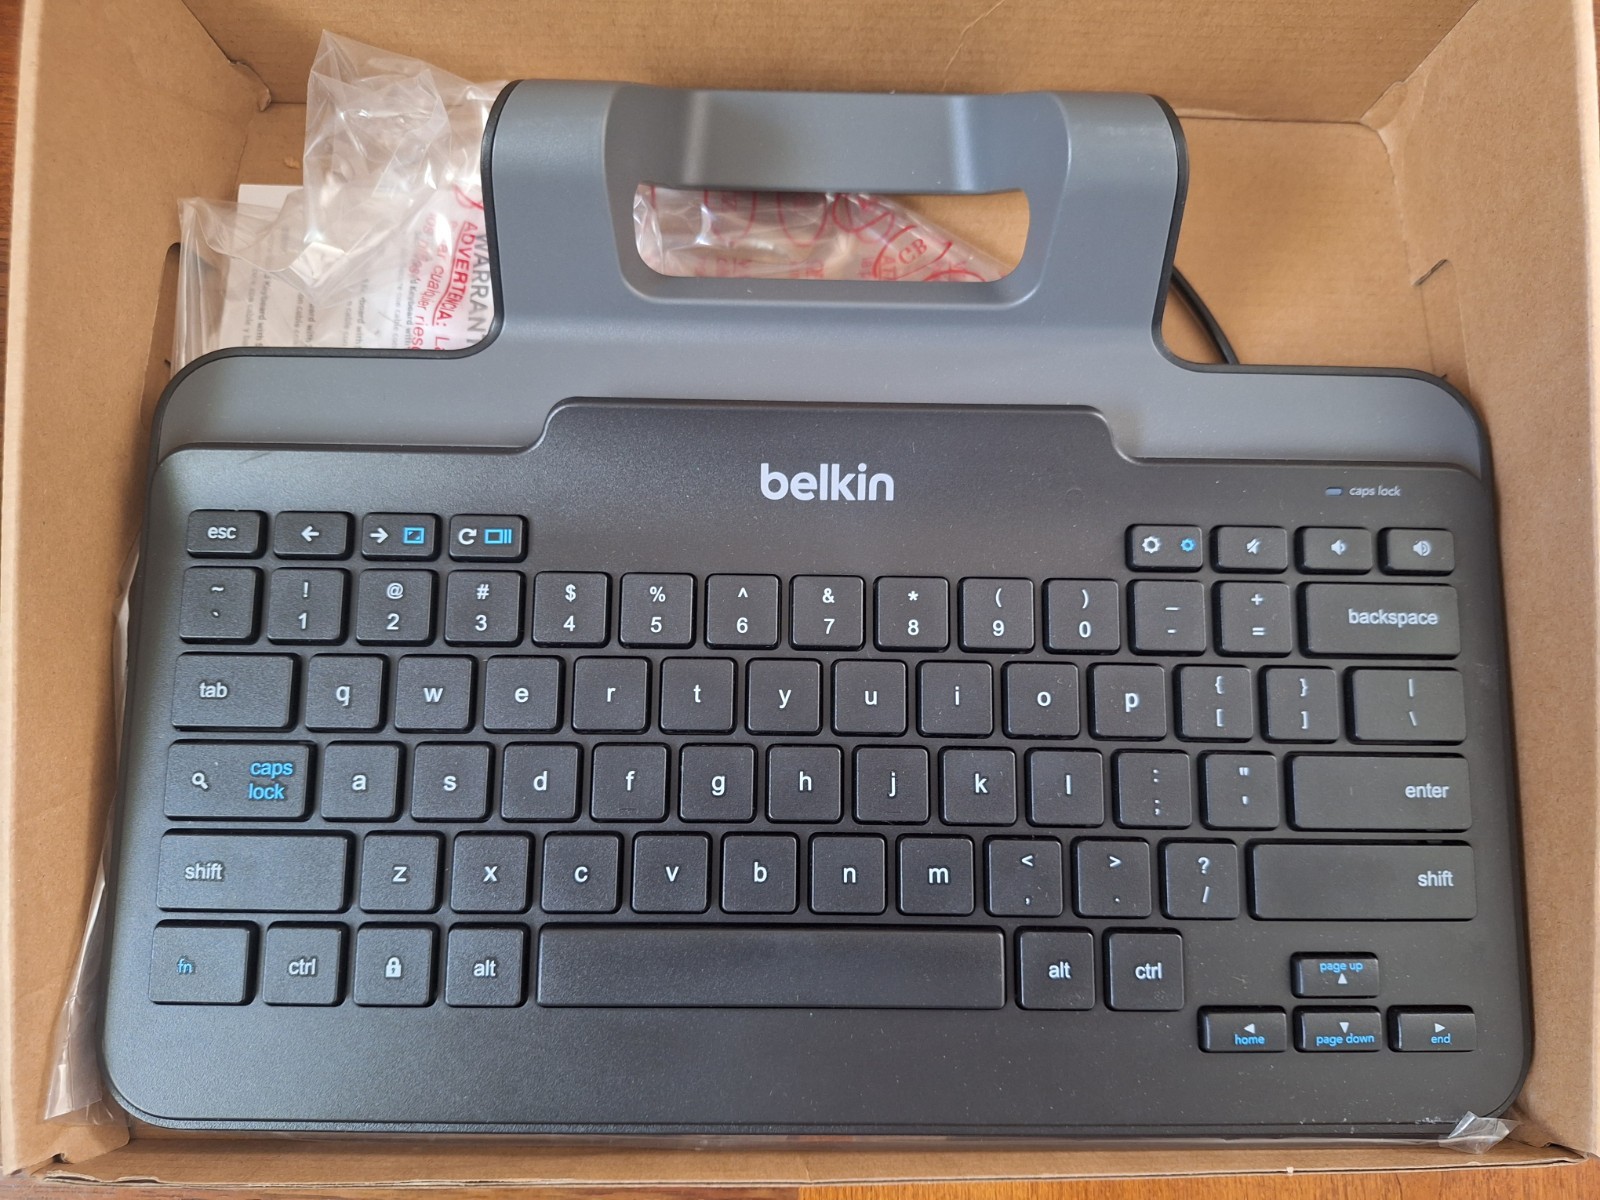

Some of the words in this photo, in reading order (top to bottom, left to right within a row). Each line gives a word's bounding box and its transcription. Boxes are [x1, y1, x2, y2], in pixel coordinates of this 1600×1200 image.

[436, 221, 478, 327] ADVERTENCIA:
[760, 462, 895, 502] belkin
[1349, 487, 1375, 498] caps
[1377, 485, 1401, 497] lock
[207, 526, 237, 539] esc
[303, 581, 309, 598] !
[386, 582, 404, 600] @
[476, 583, 490, 600] #
[564, 583, 577, 603] $
[649, 586, 666, 603] %
[822, 587, 835, 604] &
[995, 587, 1002, 608] (
[1081, 589, 1089, 609] )
[1251, 593, 1264, 606] +
[298, 612, 307, 630] 1
[386, 613, 400, 630] 2
[474, 614, 488, 632] 3
[563, 615, 576, 632] 4
[650, 616, 663, 633] 5
[736, 616, 749, 634] 6
[823, 618, 835, 635] 7
[1348, 608, 1439, 628] backspace
[907, 619, 920, 636] 8
[992, 619, 1005, 637] 9
[1078, 620, 1092, 638] 0
[1252, 627, 1265, 636] =
[199, 682, 228, 698] tab
[693, 684, 701, 703] t
[1214, 675, 1223, 695] {
[1299, 678, 1308, 697] }
[335, 685, 350, 707] q
[423, 687, 444, 703] w
[514, 687, 529, 703] e
[606, 687, 616, 703] r
[778, 689, 792, 709] y
[864, 690, 878, 706] u
[955, 685, 960, 706] i
[1037, 691, 1052, 707] o
[1125, 692, 1140, 713] p
[1216, 708, 1223, 727] [
[1300, 710, 1308, 730] ]
[1408, 711, 1417, 726] \
[249, 762, 293, 779] caps
[1153, 769, 1159, 783] :
[1238, 767, 1249, 776] "
[351, 774, 367, 791] a
[443, 775, 457, 792] s
[533, 770, 548, 791] d
[625, 770, 636, 791] f
[711, 775, 726, 796] g
[799, 770, 812, 791] h
[888, 771, 896, 797] j
[974, 773, 988, 794] k
[1065, 774, 1071, 795] l
[248, 783, 285, 800] lock
[1404, 783, 1450, 799] enter
[1154, 799, 1160, 815] ;
[1021, 855, 1033, 867] <
[1109, 856, 1122, 867] >
[1198, 856, 1210, 874] ?
[184, 862, 223, 880] shift
[392, 866, 407, 882] z
[483, 866, 498, 882] x
[574, 866, 588, 883] c
[665, 866, 680, 882] v
[753, 861, 768, 883] b
[843, 867, 856, 883] n
[928, 867, 949, 884] m
[1417, 870, 1454, 887] shift
[1202, 886, 1210, 903] /
[177, 958, 193, 973] fn
[288, 958, 316, 975] ctrl
[473, 959, 496, 977] alt
[1048, 961, 1071, 979] alt
[1135, 962, 1163, 980] ctrl
[1319, 962, 1346, 974] page
[1348, 962, 1364, 973] up
[1234, 1033, 1265, 1045] home
[1316, 1036, 1344, 1047] page
[1345, 1034, 1375, 1044] down
[1430, 1033, 1451, 1044] end
